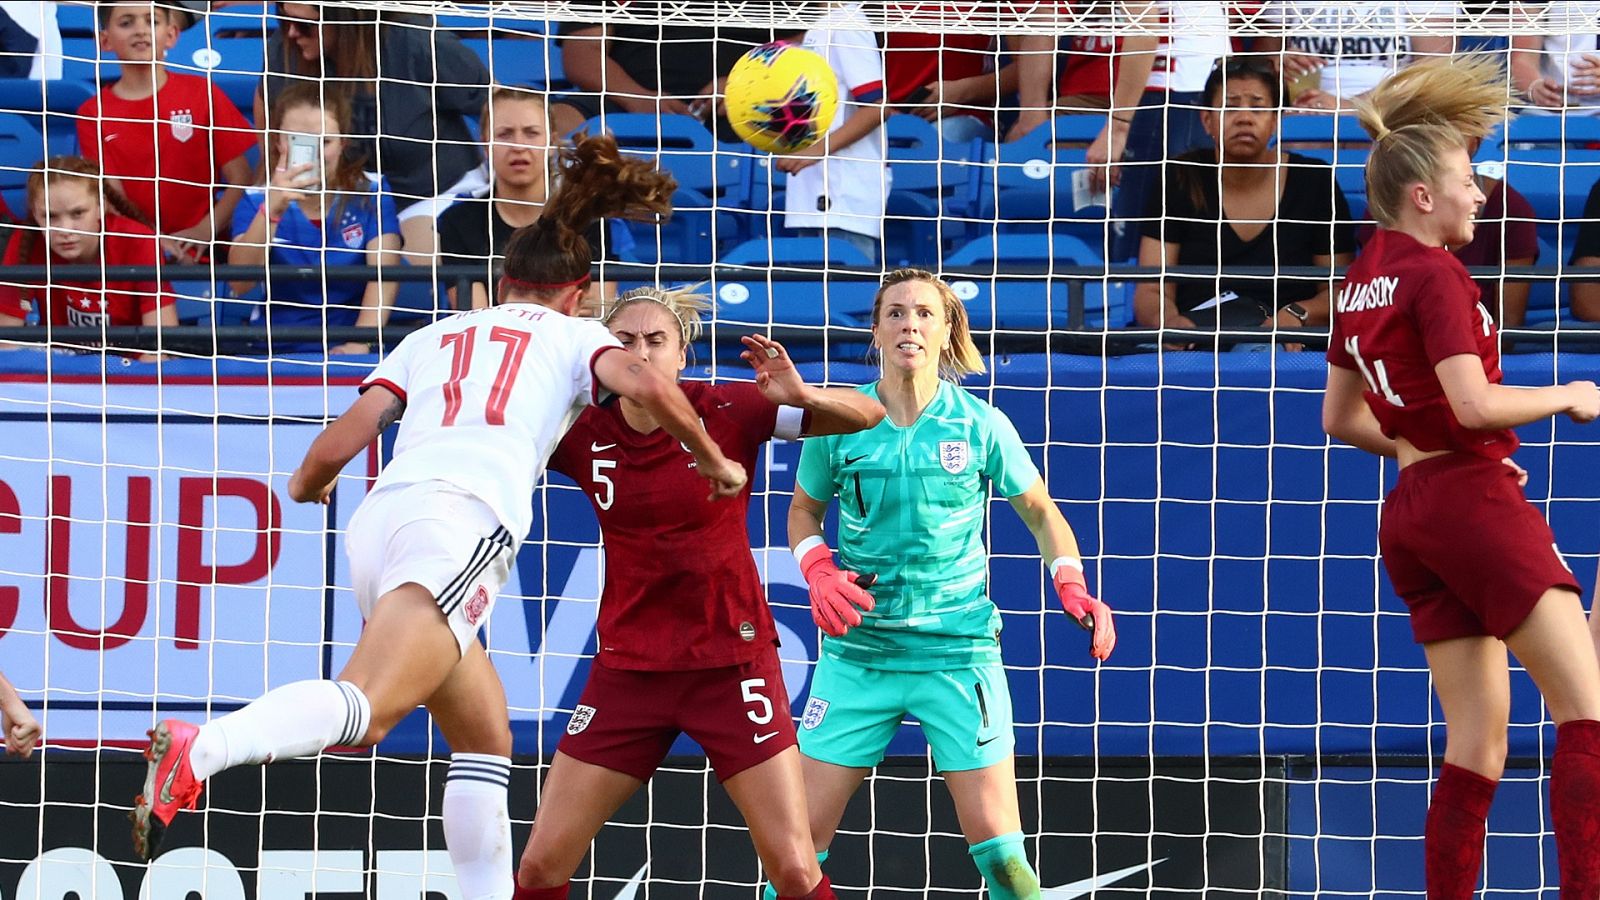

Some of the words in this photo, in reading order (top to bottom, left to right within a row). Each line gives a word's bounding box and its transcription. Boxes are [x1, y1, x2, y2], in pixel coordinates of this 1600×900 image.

[440, 325, 532, 427] 17
[592, 459, 617, 511] 5
[853, 471, 866, 518] 1
[0, 475, 282, 650] UP
[740, 678, 774, 725] 5
[974, 682, 989, 728] 1
